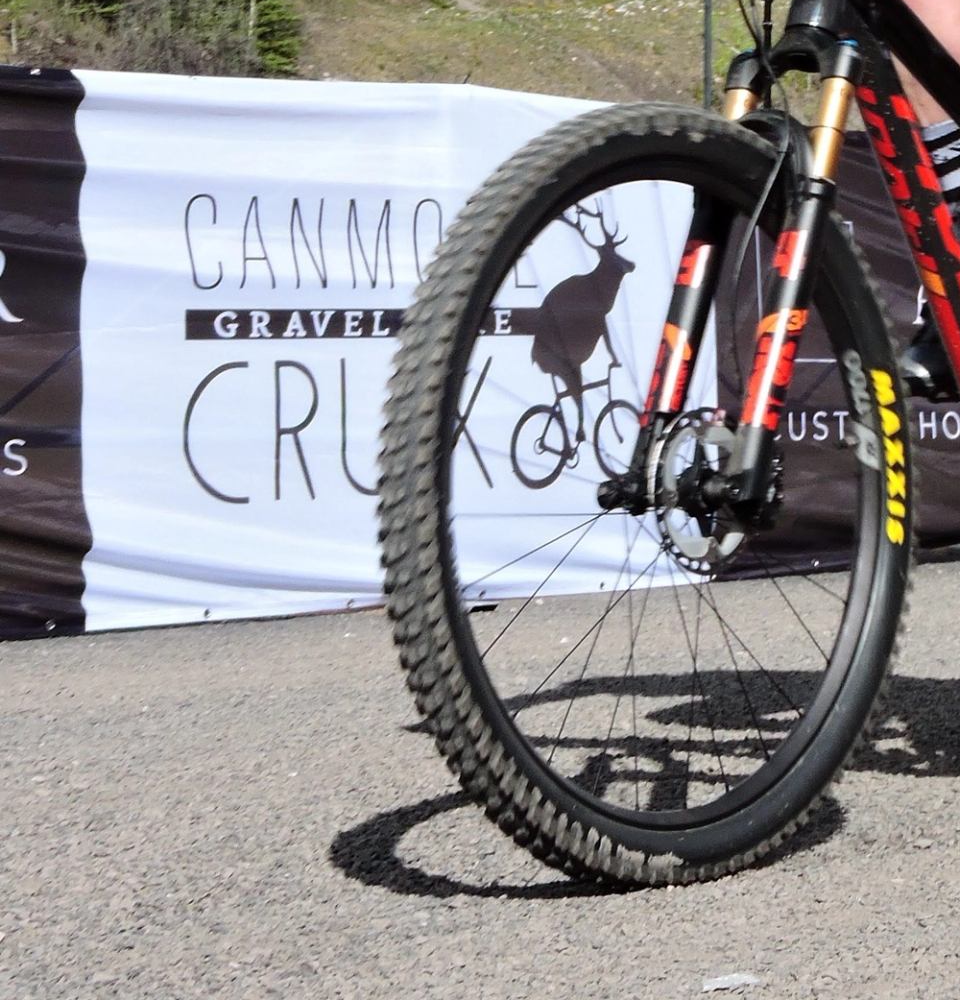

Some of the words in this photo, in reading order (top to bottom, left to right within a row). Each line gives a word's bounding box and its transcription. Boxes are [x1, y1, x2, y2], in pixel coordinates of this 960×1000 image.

[184, 193, 539, 290] CANMO
[214, 309, 391, 340] GRAVEL
[870, 368, 906, 545] MAXXIS
